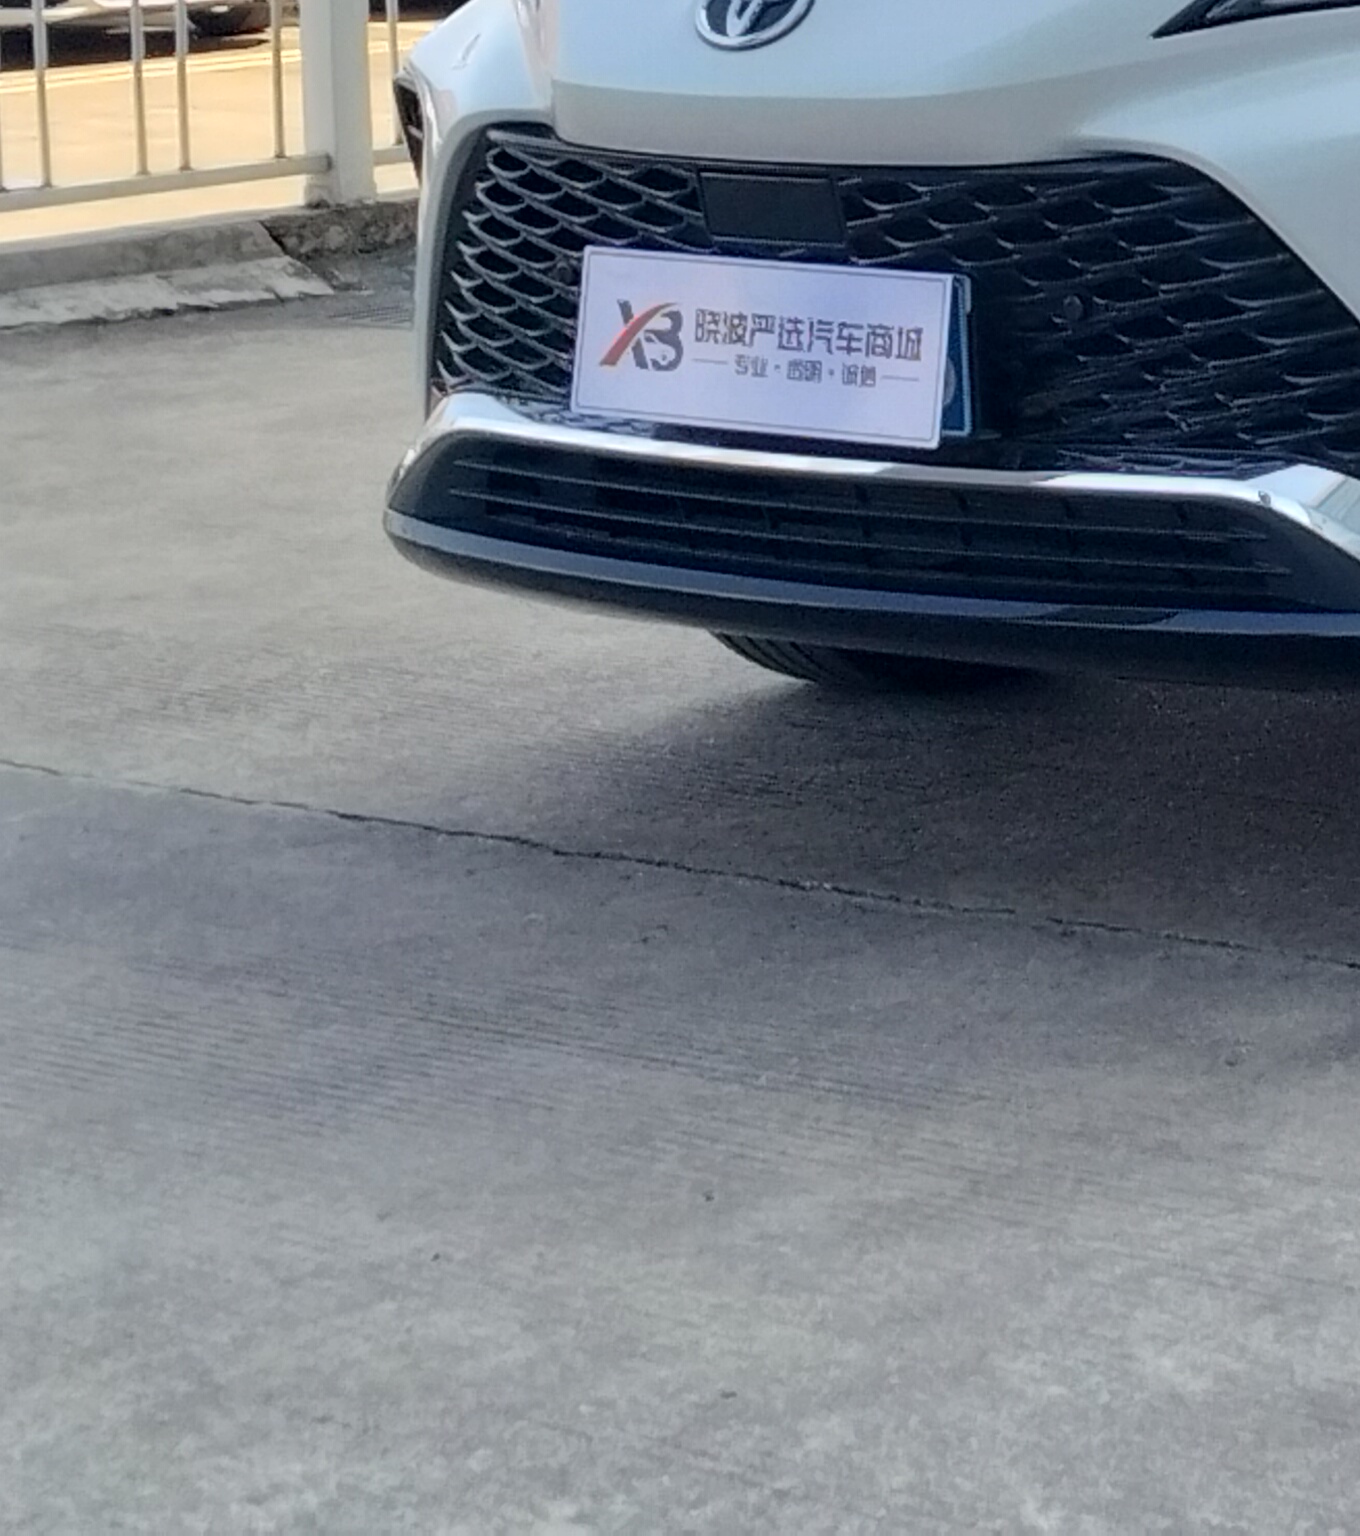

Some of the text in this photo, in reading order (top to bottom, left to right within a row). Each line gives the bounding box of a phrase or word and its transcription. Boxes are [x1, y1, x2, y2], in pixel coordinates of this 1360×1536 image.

[694, 308, 925, 362] 晓波严选汽车商城
